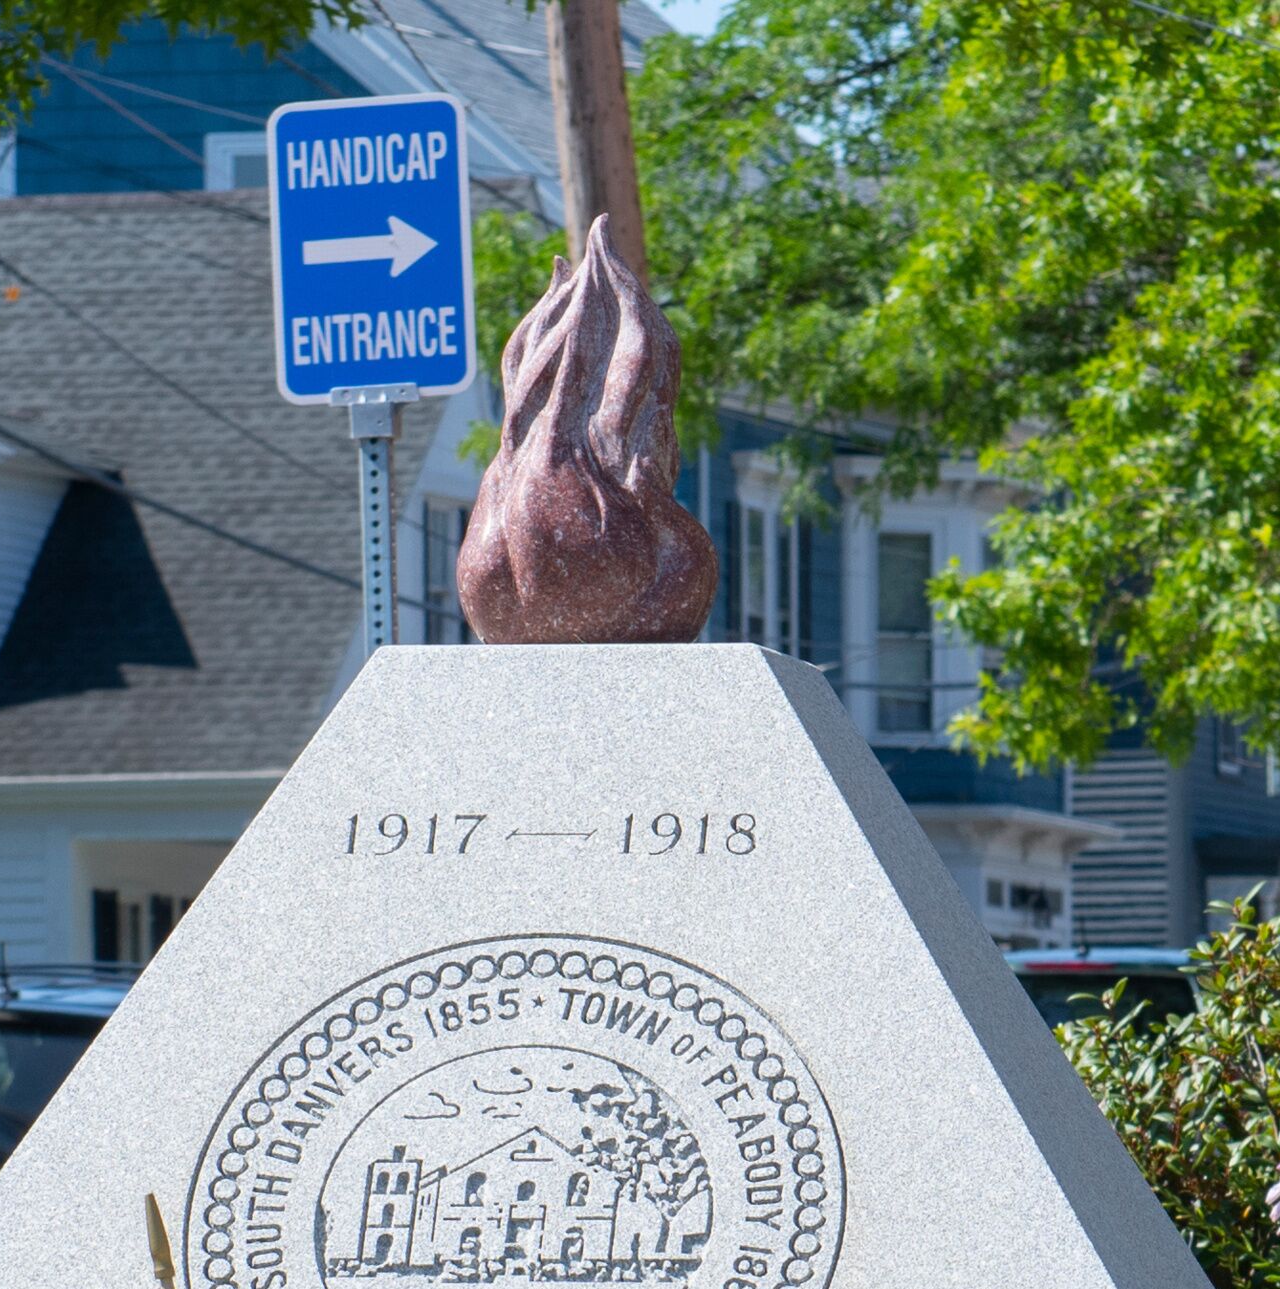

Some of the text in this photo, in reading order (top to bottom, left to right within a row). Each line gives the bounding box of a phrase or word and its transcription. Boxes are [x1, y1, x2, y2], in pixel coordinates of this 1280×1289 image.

[286, 131, 448, 190] HANDICAP
[292, 306, 458, 367] ENTRANCE
[344, 812, 488, 857] 1917
[619, 812, 757, 857] 1918
[265, 1021, 415, 1166] DANVERS
[424, 987, 520, 1039] 1855
[558, 988, 672, 1046] TOWN
[671, 1033, 710, 1066] OF
[703, 1063, 786, 1232] PEABODY
